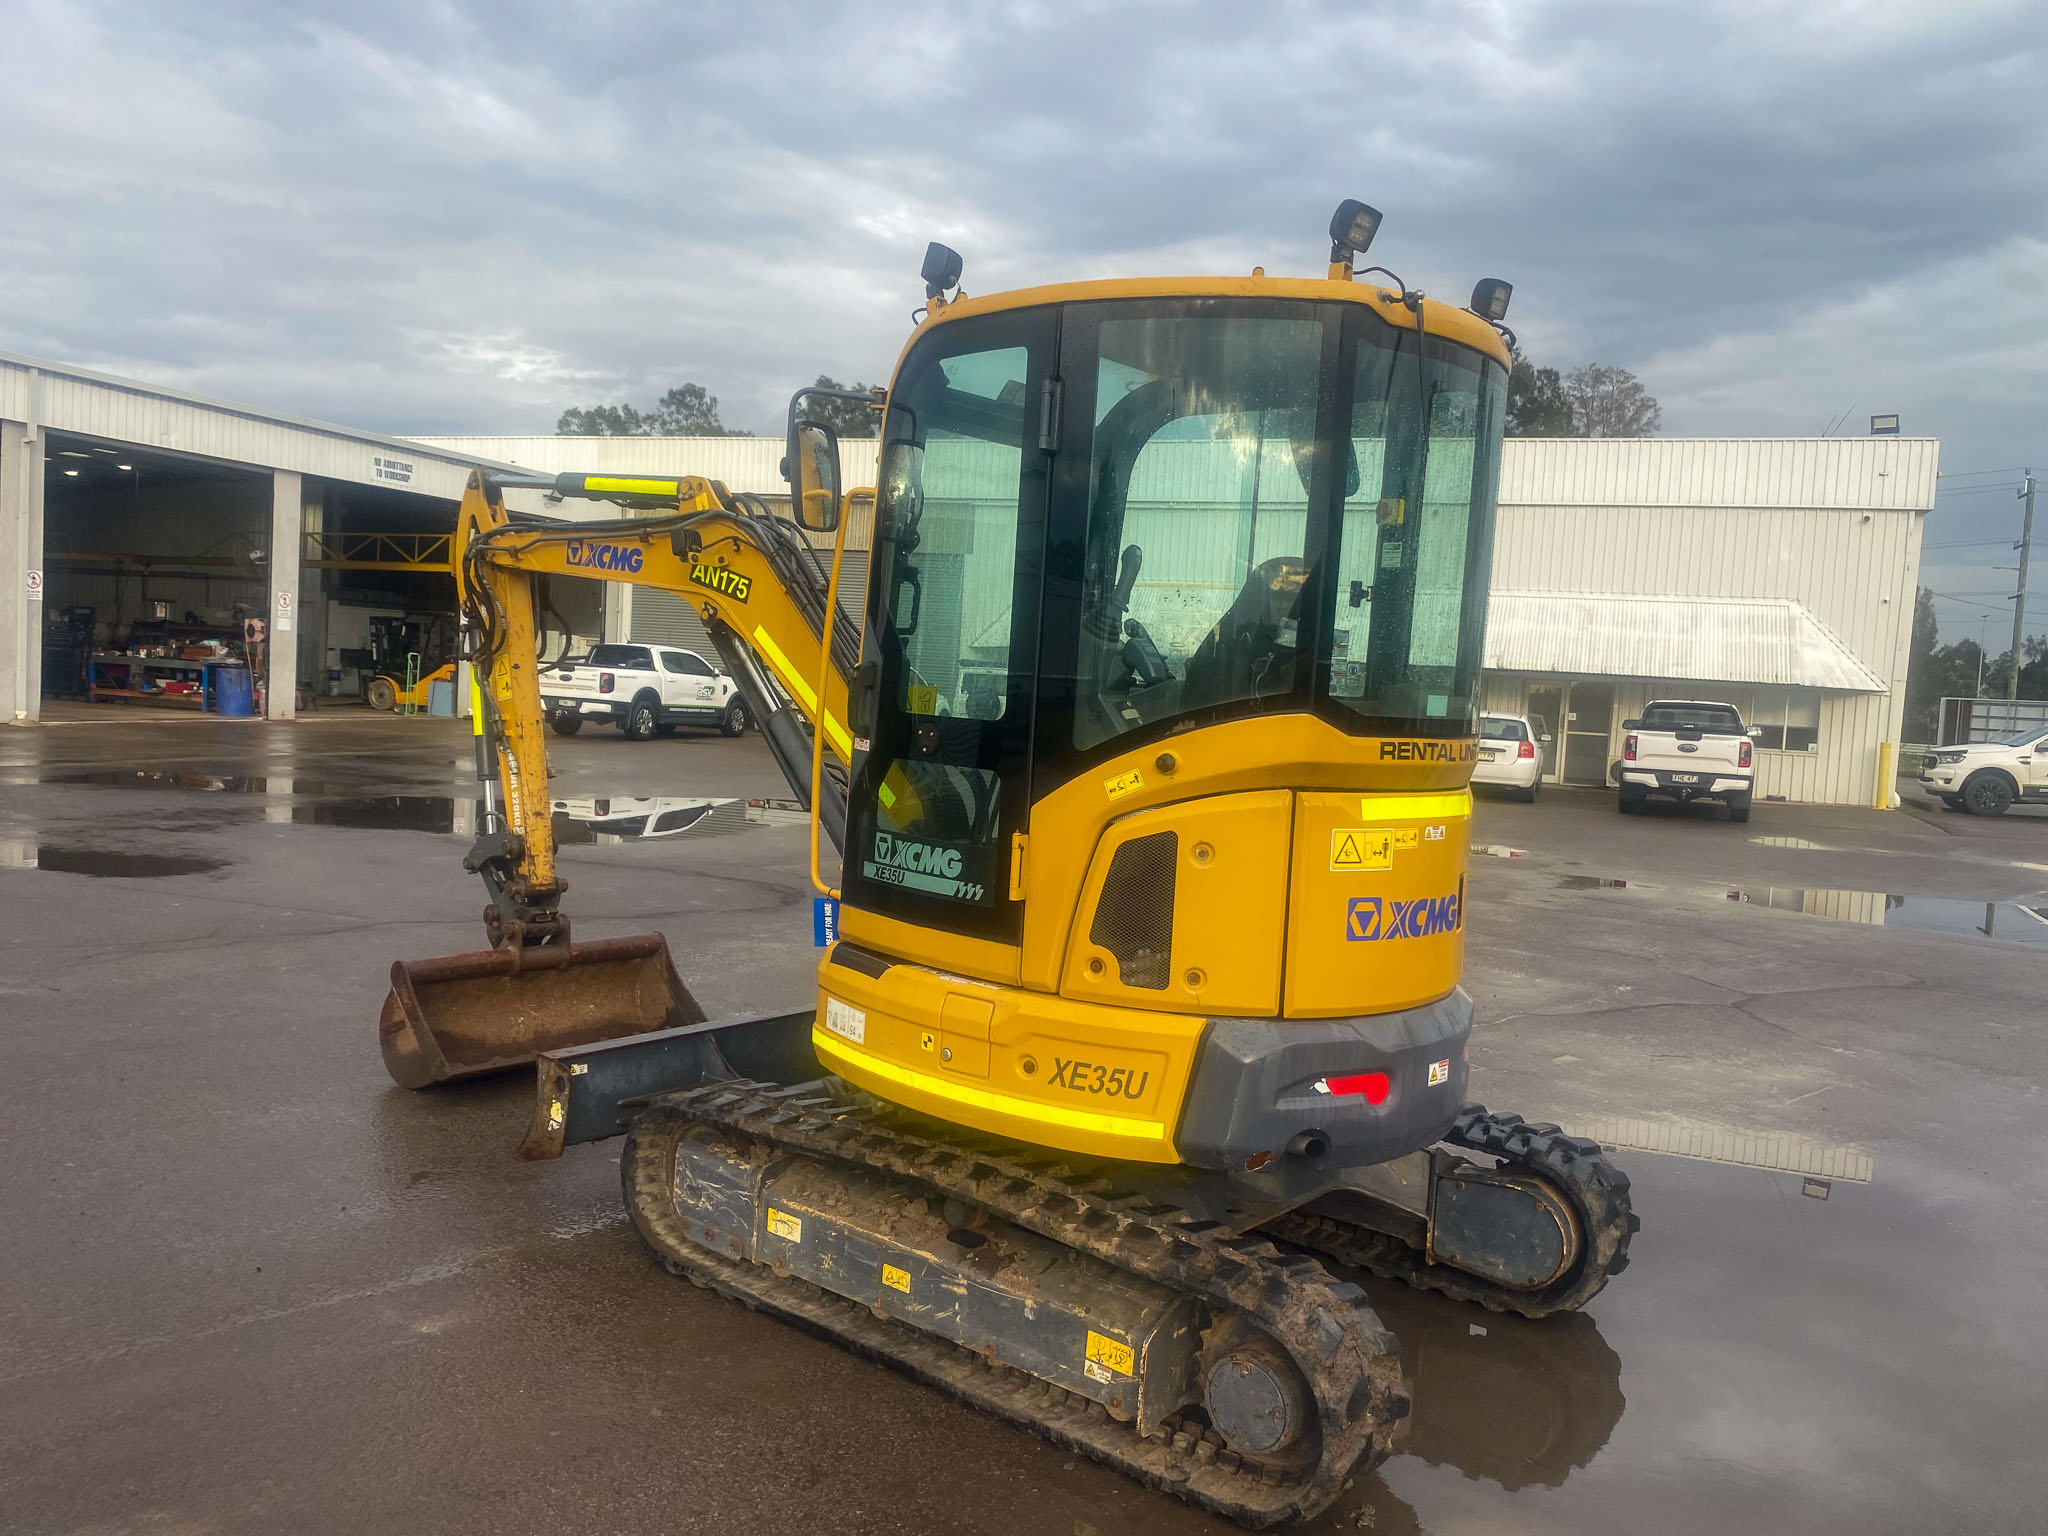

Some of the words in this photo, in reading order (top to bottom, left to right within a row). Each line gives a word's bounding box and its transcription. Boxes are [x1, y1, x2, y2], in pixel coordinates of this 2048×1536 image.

[374, 457, 382, 467] NO
[376, 467, 383, 478] TO
[384, 470, 411, 482] WORKSHOP
[583, 543, 643, 573] XCMG
[691, 564, 749, 599] AN175
[1379, 741, 1457, 761] RENTAL
[890, 839, 963, 878] XCMG
[873, 865, 905, 884] XE35U
[824, 902, 832, 916] HIRE
[1380, 893, 1457, 940] XCMG
[824, 916, 833, 928] FOR
[1047, 1057, 1149, 1100] XE35U
